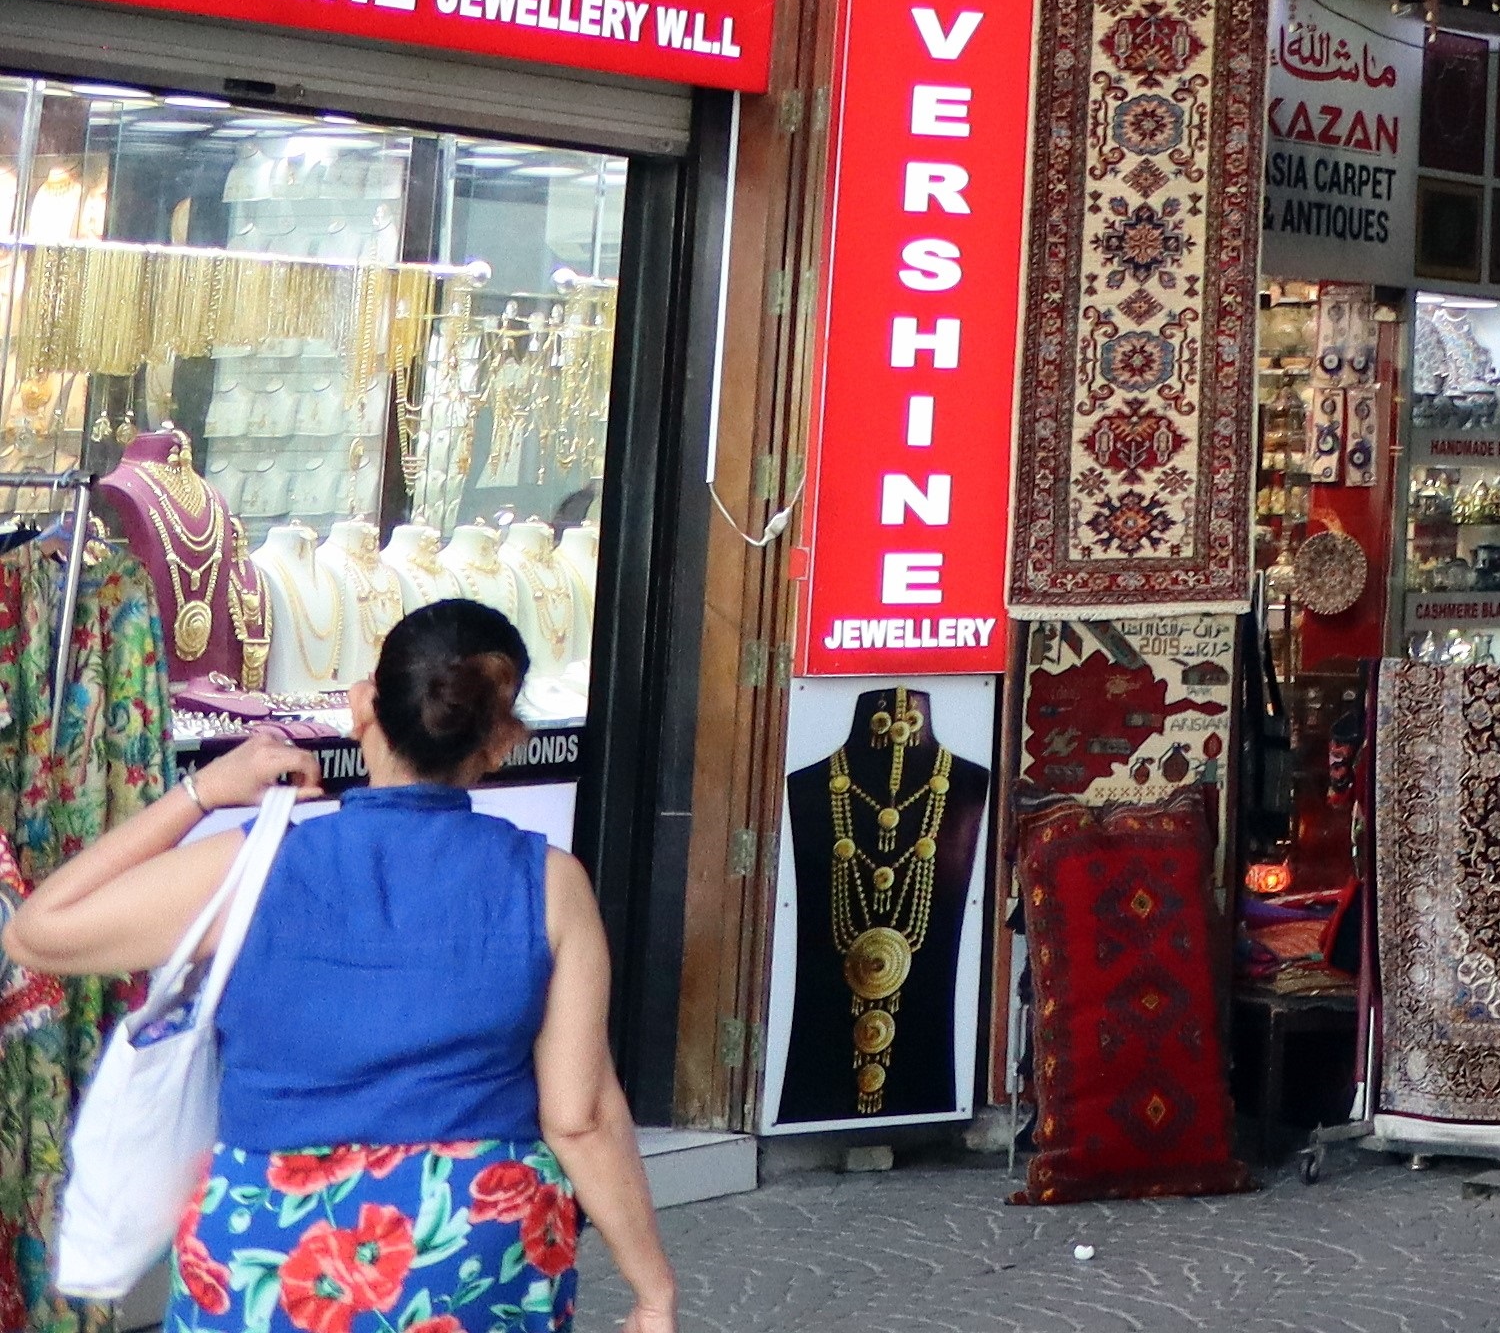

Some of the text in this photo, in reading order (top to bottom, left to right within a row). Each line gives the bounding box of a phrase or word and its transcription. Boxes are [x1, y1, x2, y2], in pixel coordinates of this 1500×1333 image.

[656, 5, 741, 59] W.L.L
[1314, 158, 1397, 202] CARPET
[1280, 199, 1390, 244] ANTIQUES
[1430, 440, 1495, 456] HANDMADE
[1415, 603, 1479, 620] CASHMERE
[825, 617, 996, 651] JEWELLERY
